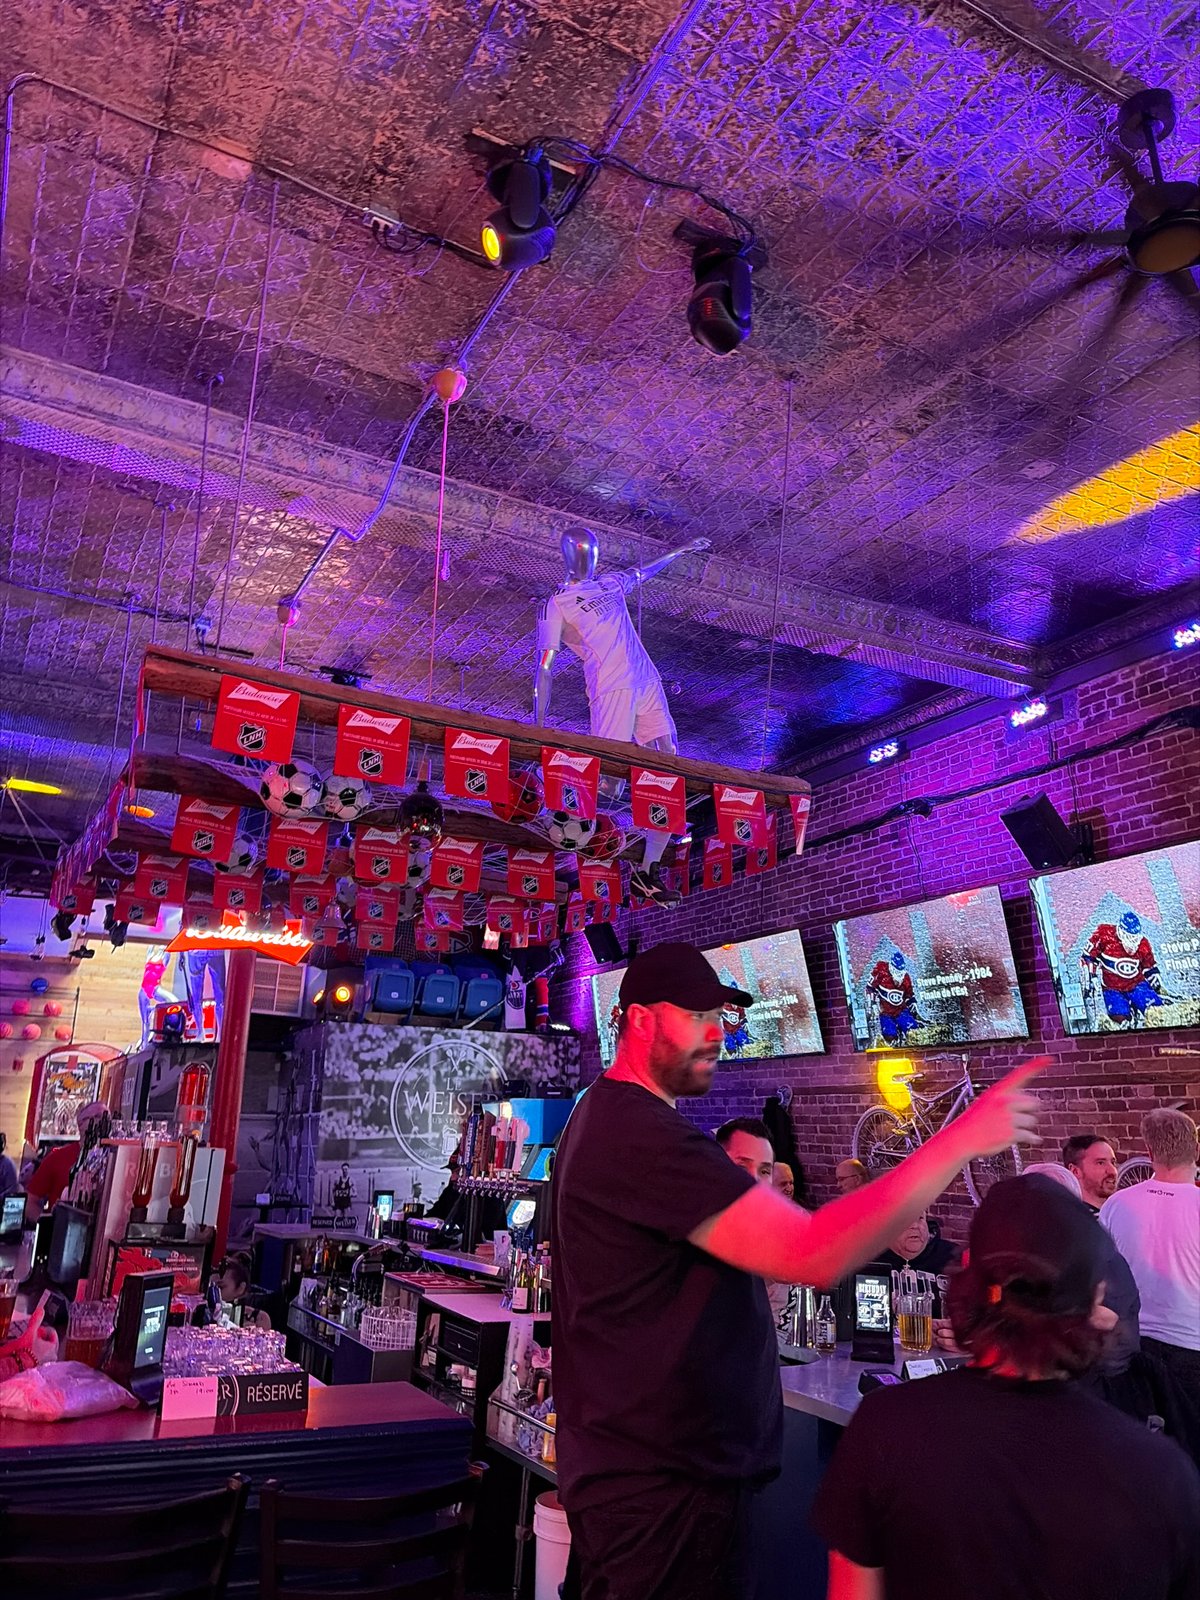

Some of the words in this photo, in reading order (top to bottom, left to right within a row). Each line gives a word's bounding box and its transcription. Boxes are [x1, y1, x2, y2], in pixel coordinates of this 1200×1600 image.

[235, 686, 284, 703] Budweiser
[352, 713, 396, 729] Budweiser
[243, 730, 262, 744] LNH
[457, 736, 497, 749] Budweiser
[363, 755, 380, 769] LNH
[640, 774, 675, 786] Budweiser
[1160, 940, 1190, 954] Steve
[1165, 956, 1199, 970] Finale
[917, 977, 936, 987] Steve
[970, 966, 993, 980] 1984
[920, 990, 941, 1000] Finale
[942, 987, 951, 998] de
[446, 1077, 462, 1091] LE
[247, 1380, 302, 1402] RÉSERVÉ
